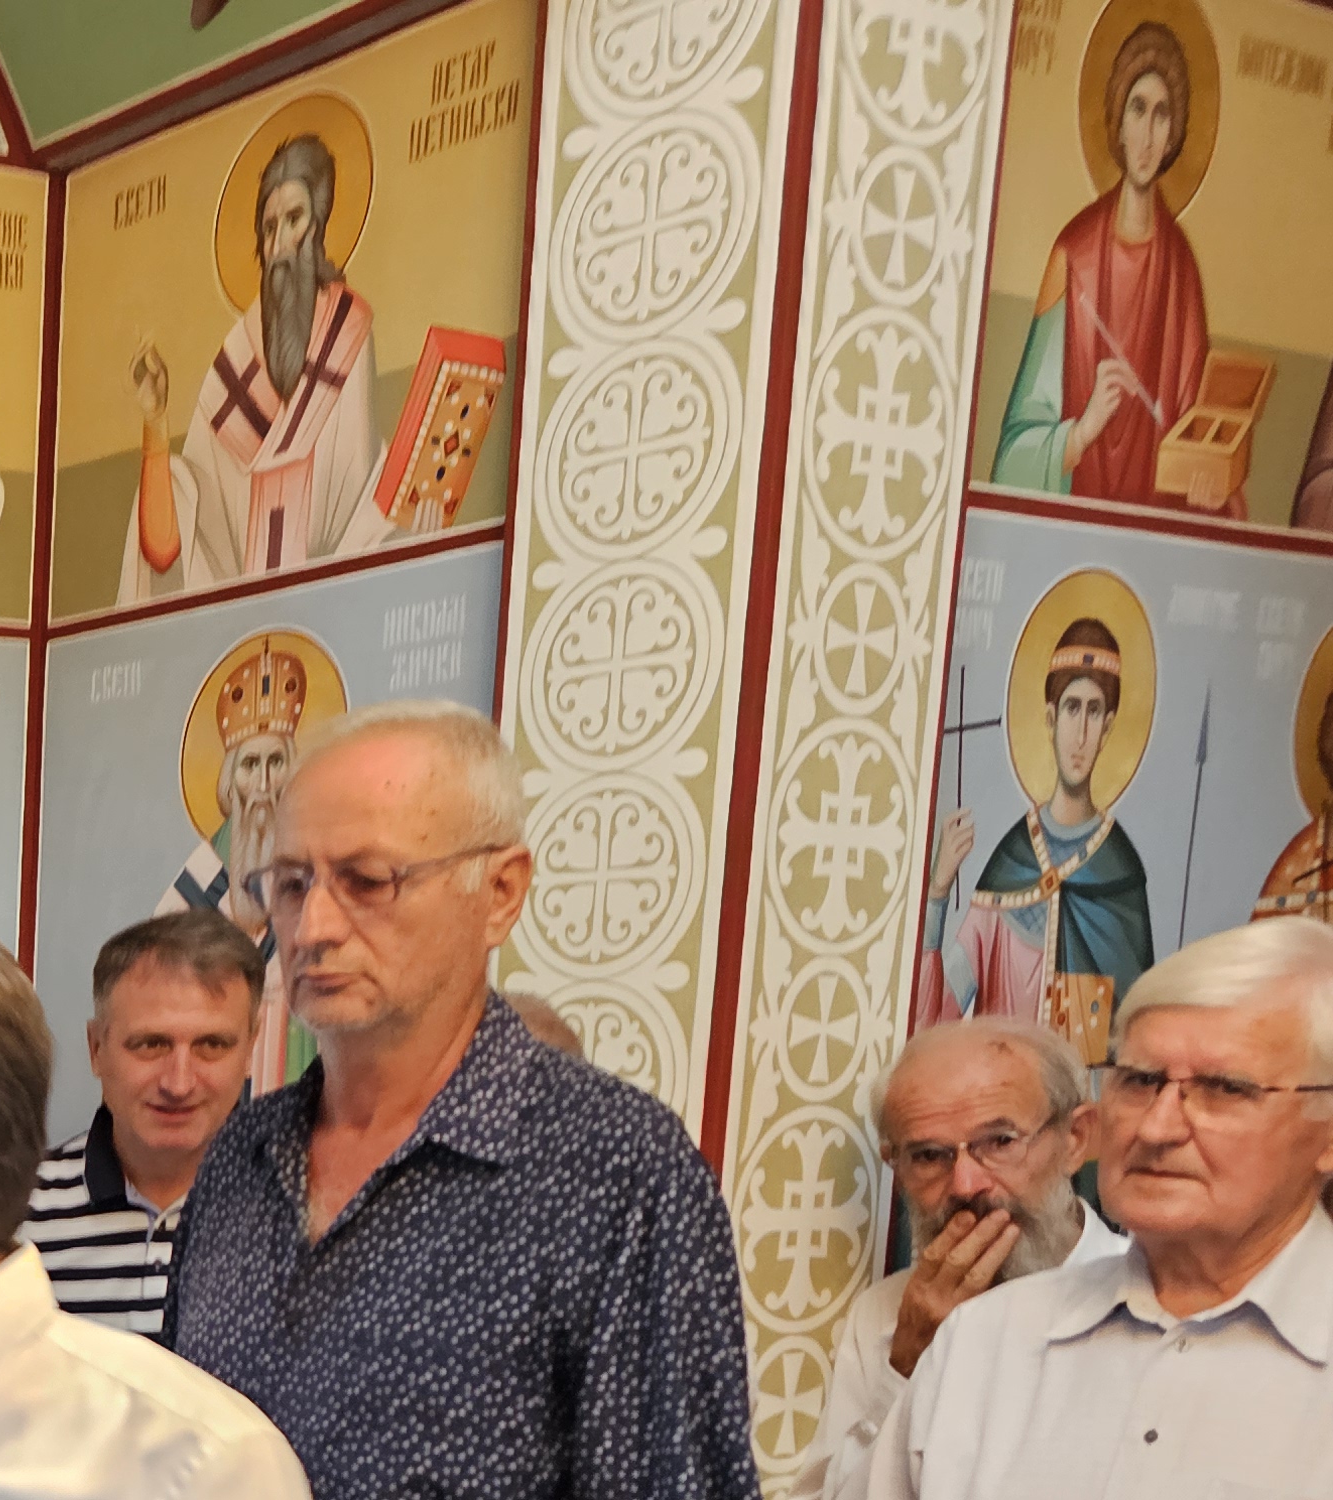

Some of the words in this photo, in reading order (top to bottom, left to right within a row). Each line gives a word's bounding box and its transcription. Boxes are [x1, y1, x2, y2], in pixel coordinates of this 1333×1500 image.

[431, 38, 496, 107] ПЕТАР
[113, 173, 167, 232] СВЕТИ
[90, 658, 142, 704] СВЕТИ
